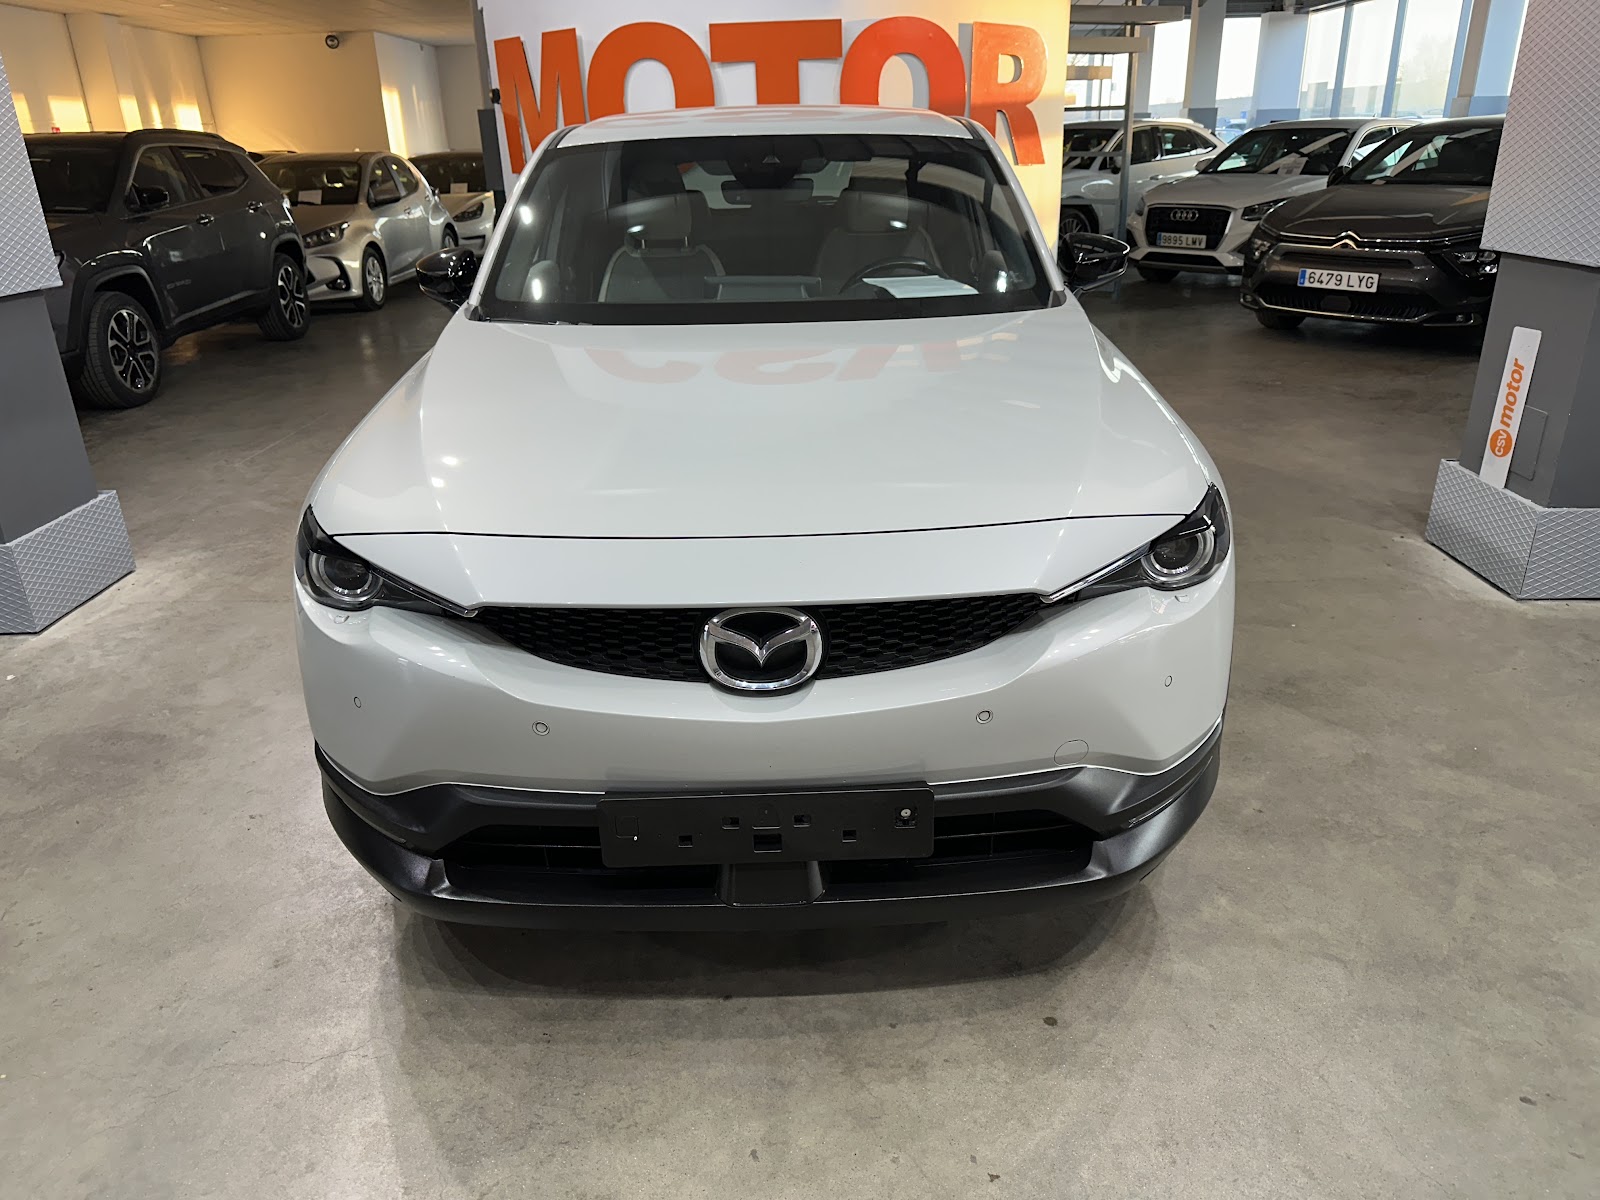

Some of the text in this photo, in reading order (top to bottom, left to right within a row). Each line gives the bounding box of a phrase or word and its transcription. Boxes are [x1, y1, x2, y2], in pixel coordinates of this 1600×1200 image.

[494, 16, 1048, 174] MOTOR
[1162, 234, 1184, 246] 9895
[1307, 271, 1376, 290] 6479 LYG
[1500, 357, 1525, 429] motor
